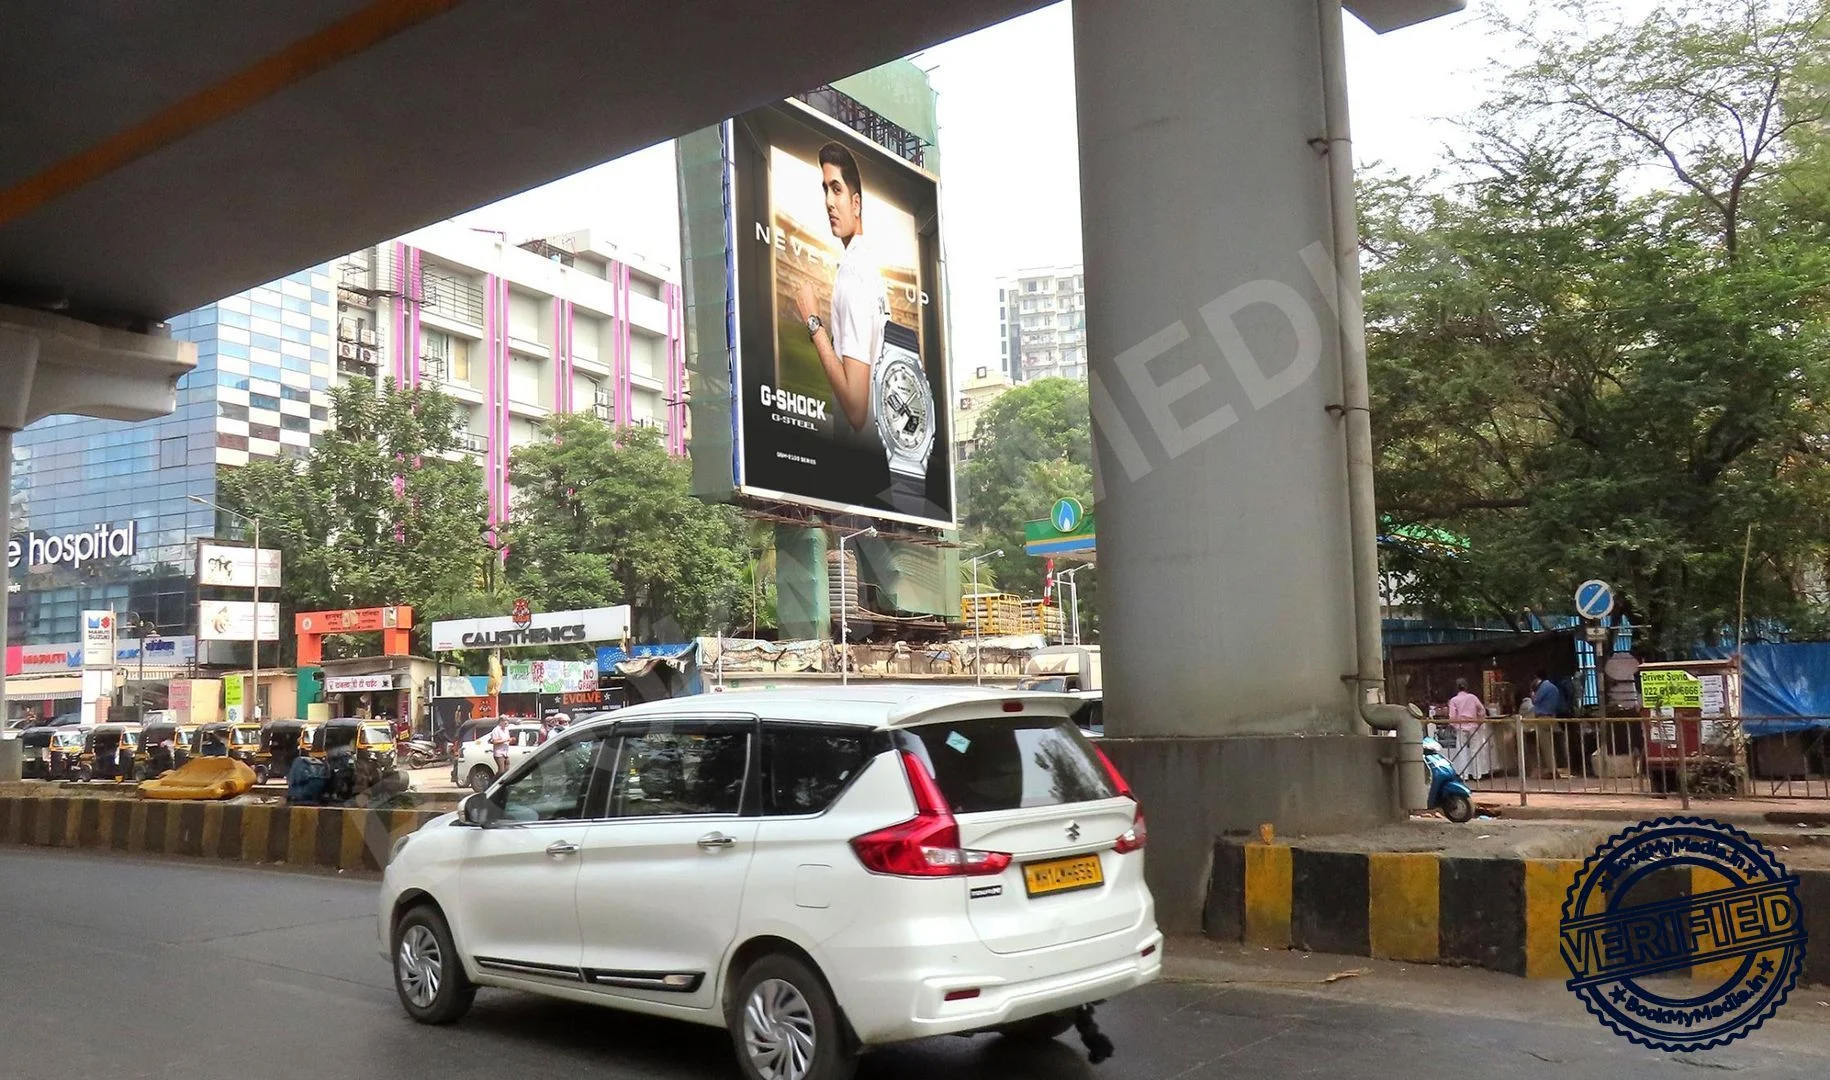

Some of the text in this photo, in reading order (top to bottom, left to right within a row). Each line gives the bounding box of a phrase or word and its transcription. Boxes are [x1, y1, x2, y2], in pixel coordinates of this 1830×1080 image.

[905, 287, 929, 307] UP
[760, 384, 826, 421] G-SHOCK
[771, 413, 819, 431] G-STEEL
[29, 520, 136, 568] hospital
[461, 624, 586, 646] CALISTHENICS
[583, 669, 594, 679] NO
[1642, 672, 1665, 682] Driver
[563, 692, 602, 704] EVOLVE
[1644, 687, 1657, 695] 022
